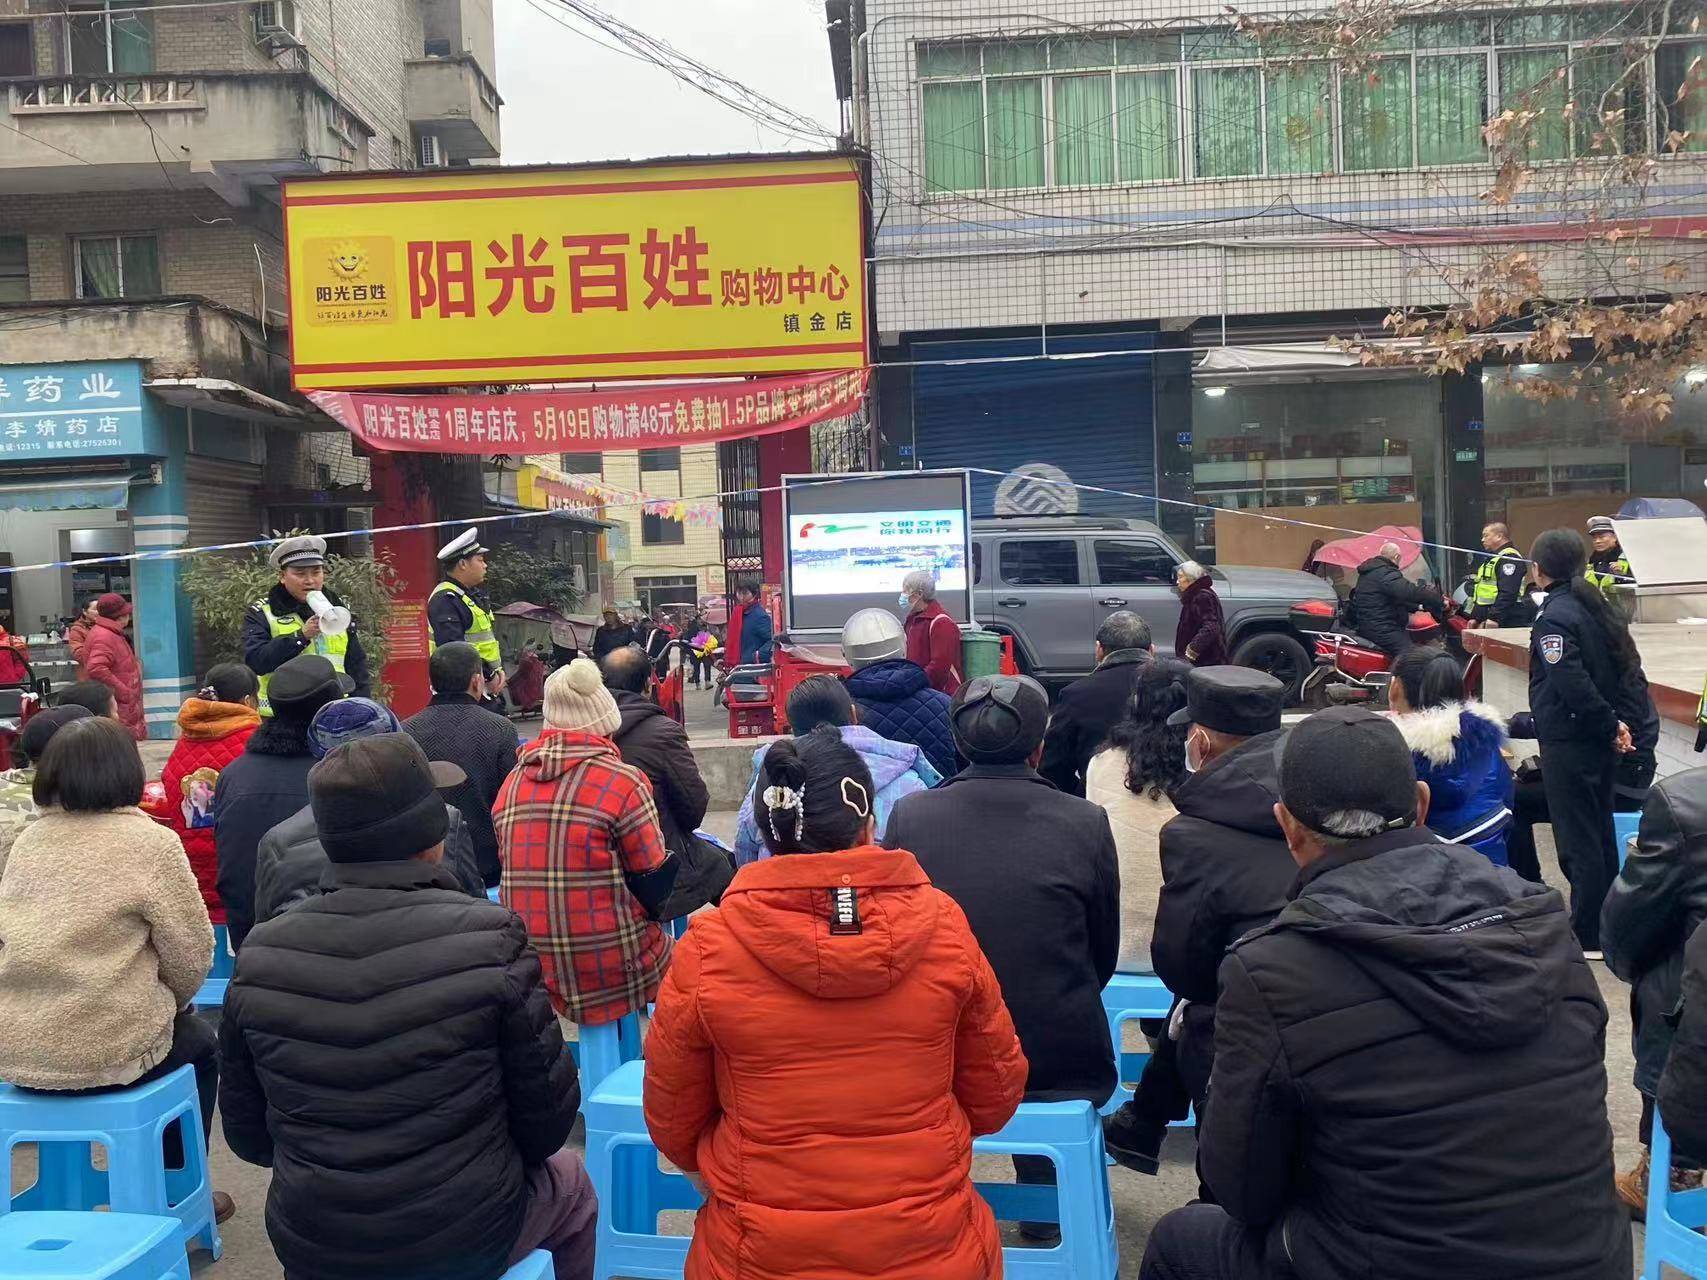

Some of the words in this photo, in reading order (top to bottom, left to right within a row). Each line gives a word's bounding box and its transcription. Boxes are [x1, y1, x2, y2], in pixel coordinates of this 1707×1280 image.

[407, 226, 712, 319] 阳光百姓
[720, 264, 850, 307] 购物中心
[316, 284, 387, 302] 阳光百姓
[784, 311, 852, 333] 镇金店
